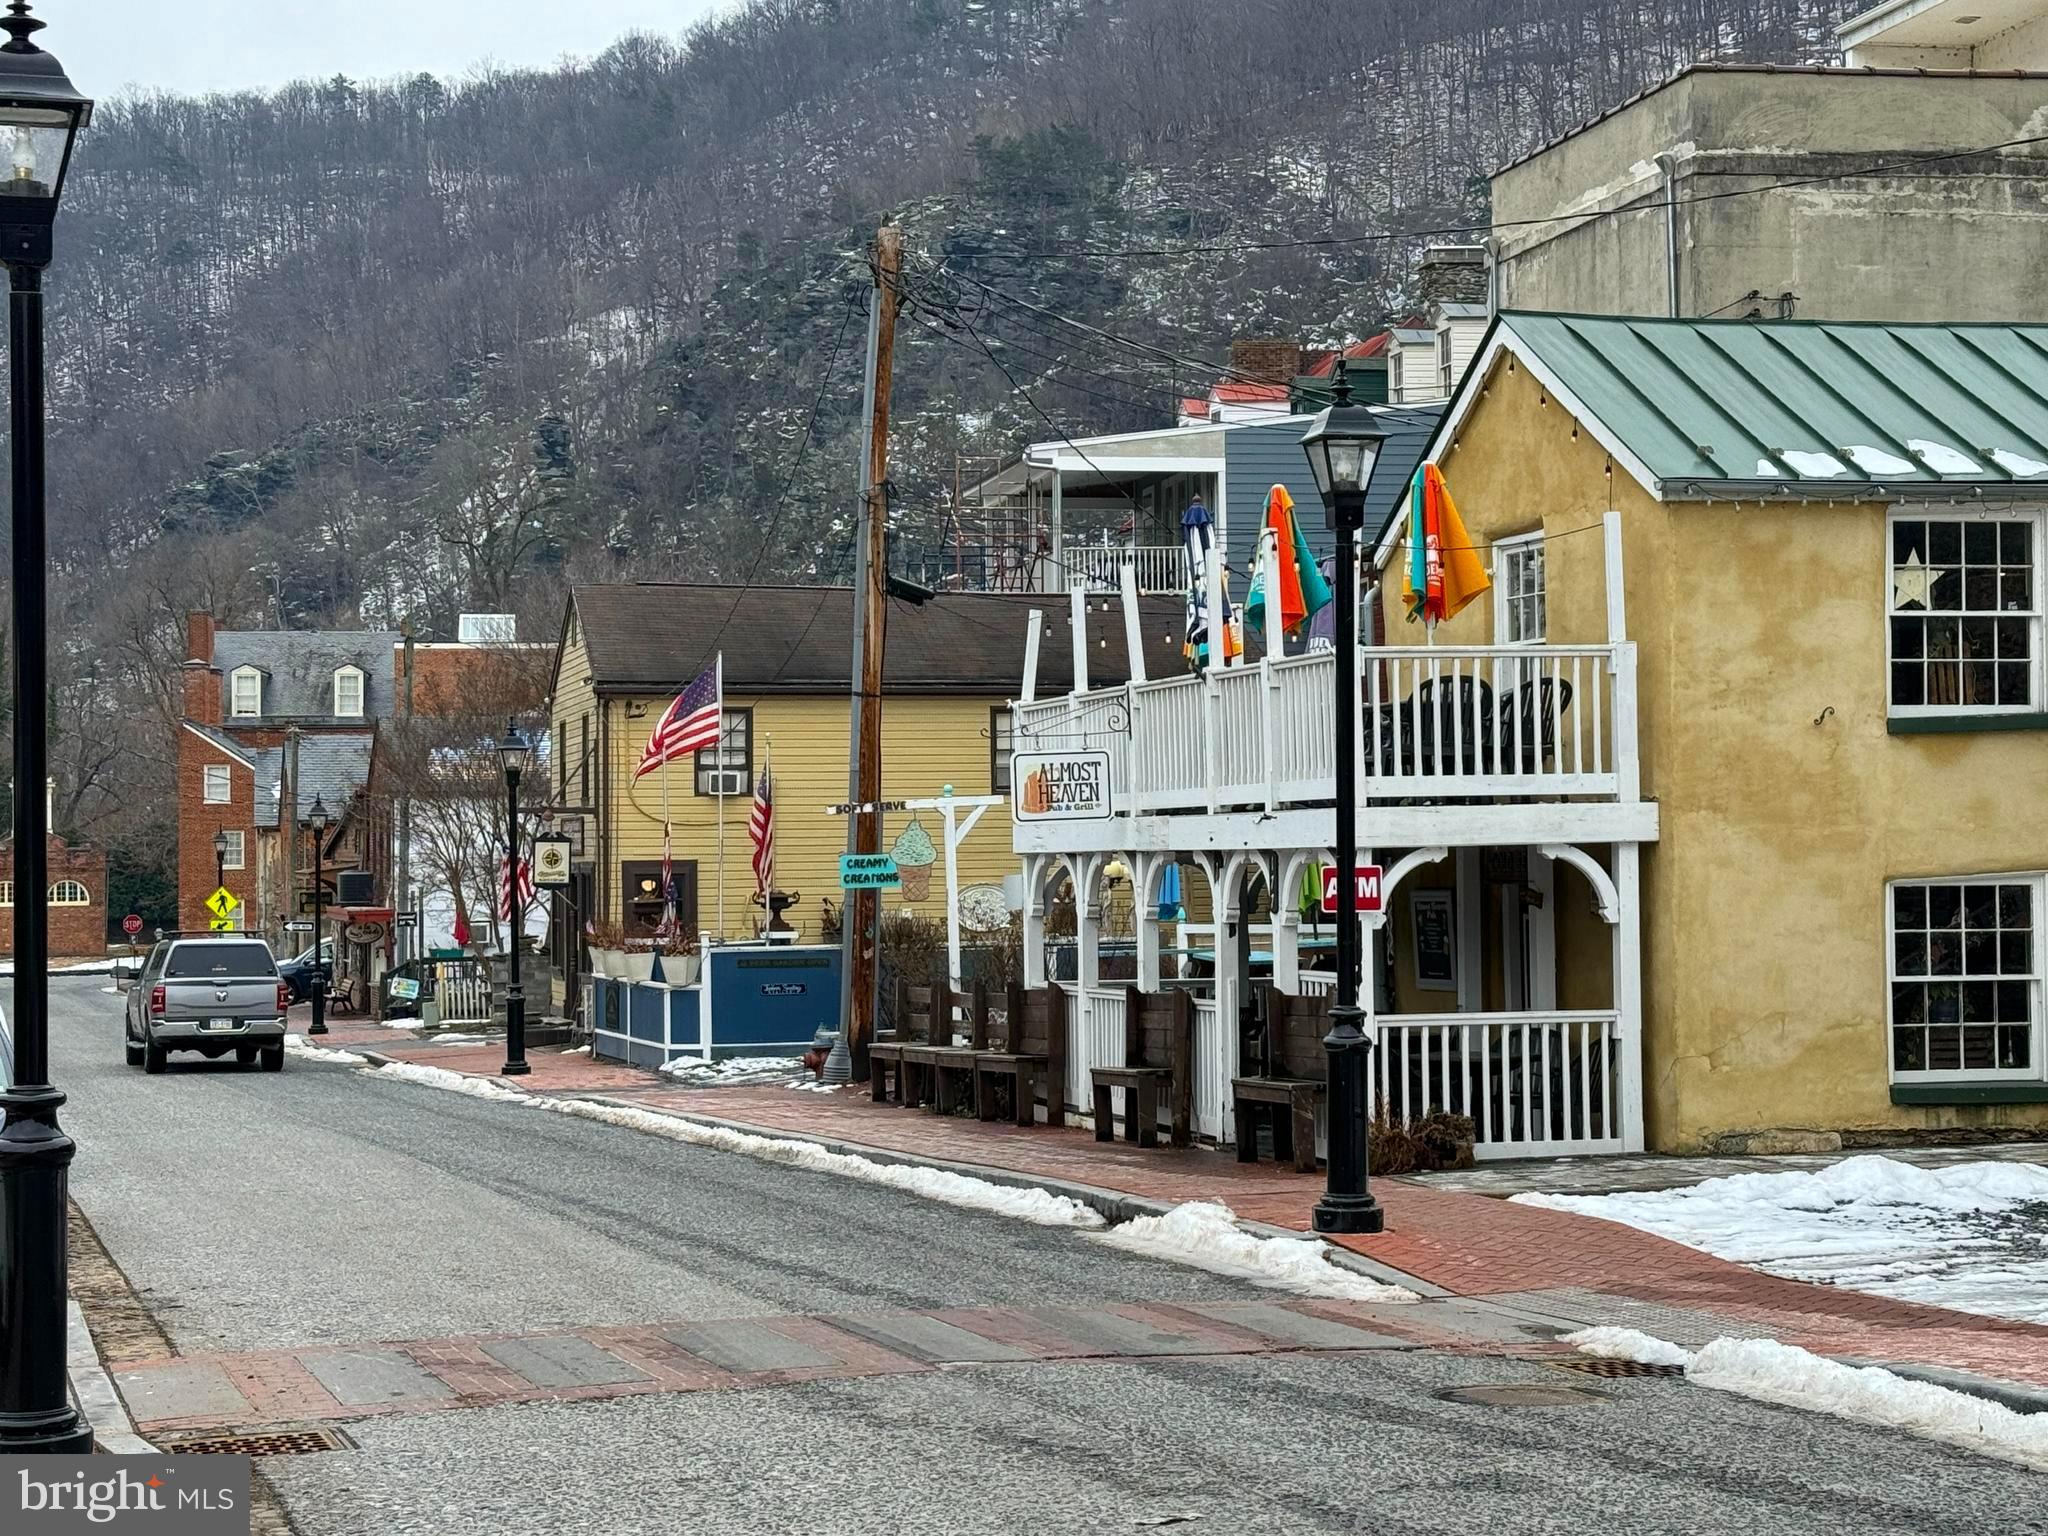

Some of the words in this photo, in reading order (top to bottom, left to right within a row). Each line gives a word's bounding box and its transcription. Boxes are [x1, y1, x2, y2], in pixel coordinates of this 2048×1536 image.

[1038, 761, 1101, 783] ALMOST
[1038, 781, 1100, 804] HEAVEN
[872, 800, 907, 812] SERVE
[1047, 804, 1063, 812] Pub
[1074, 802, 1094, 811] Grill
[846, 858, 889, 869] CREAMY
[1325, 876, 1378, 898] AM
[124, 920, 141, 930] STOP
